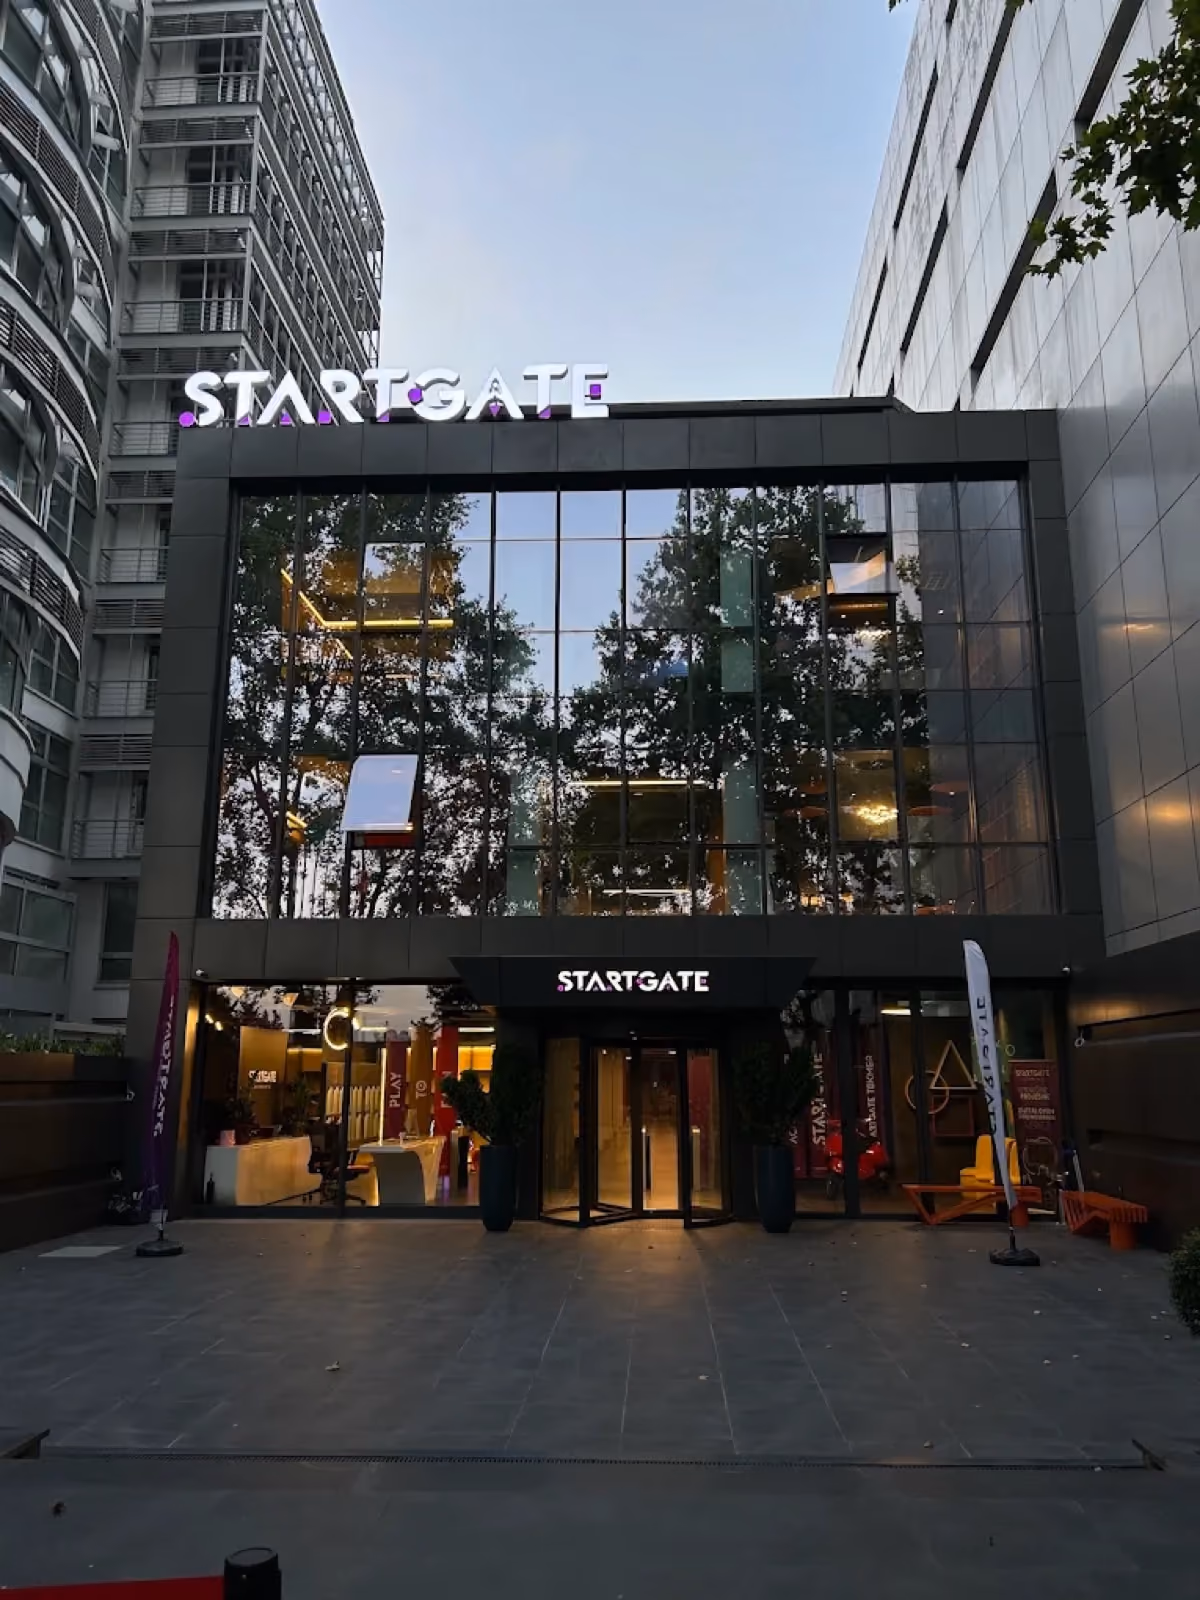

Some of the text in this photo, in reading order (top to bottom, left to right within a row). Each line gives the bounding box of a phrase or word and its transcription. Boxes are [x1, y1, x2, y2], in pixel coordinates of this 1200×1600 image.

[179, 363, 609, 427] STARTGATE
[557, 970, 710, 992] STARTGATE
[389, 1072, 402, 1108] PLAY
[415, 1080, 428, 1098] TO
[811, 1052, 826, 1146] STARTATE
